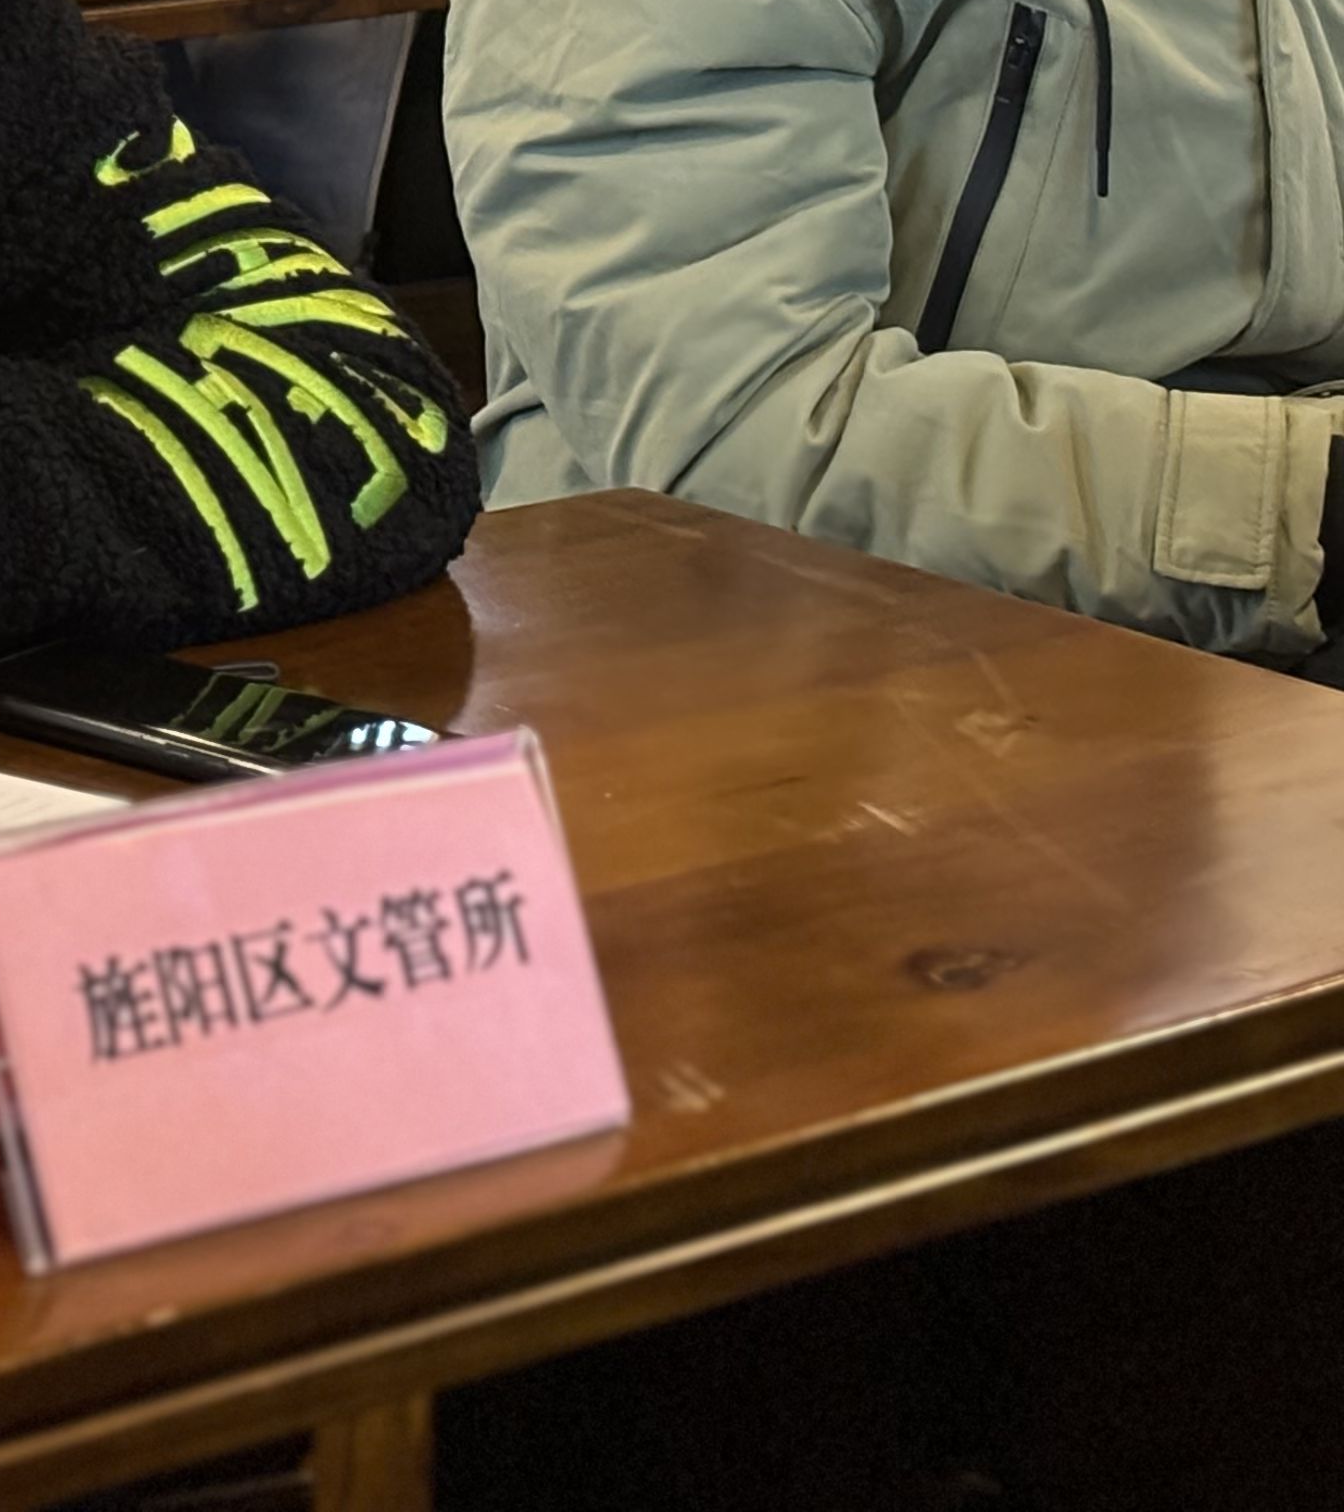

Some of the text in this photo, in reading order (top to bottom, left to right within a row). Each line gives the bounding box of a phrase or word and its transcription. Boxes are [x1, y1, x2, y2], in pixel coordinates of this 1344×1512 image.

[75, 871, 533, 1064] 旌阳区文管所
